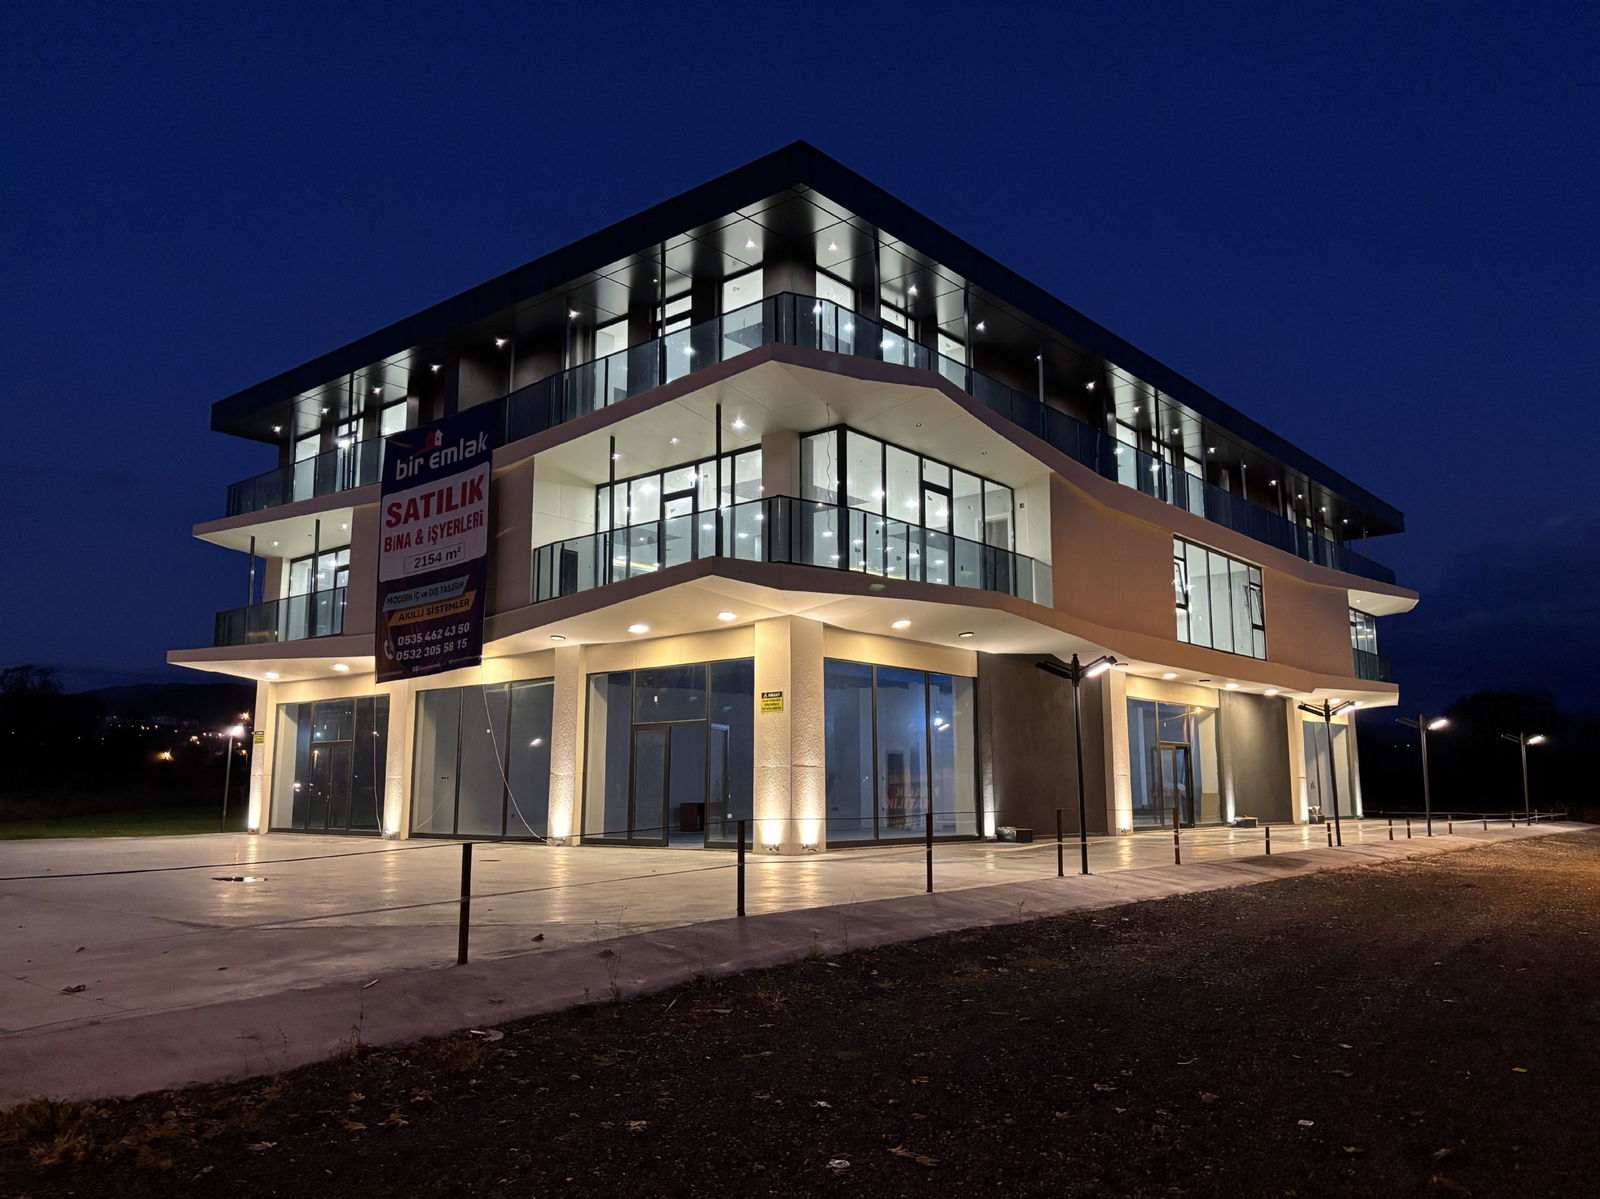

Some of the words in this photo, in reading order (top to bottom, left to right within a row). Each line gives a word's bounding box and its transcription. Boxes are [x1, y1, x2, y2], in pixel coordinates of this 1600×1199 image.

[395, 455, 424, 480] bir
[429, 431, 488, 469] emlak
[385, 474, 484, 528] SATILIK
[384, 532, 411, 552] BİNA
[415, 529, 424, 545] &
[428, 510, 483, 545] İŞYERLERİ
[415, 552, 442, 569] 2154
[398, 610, 424, 621] AKILLI
[426, 598, 470, 616] SİSTEMLER
[397, 633, 423, 646] 0535
[425, 629, 443, 641] 462
[444, 625, 456, 637] 43
[458, 622, 470, 634] 50
[396, 648, 422, 661] 0532
[423, 644, 441, 657] 305
[456, 638, 468, 650] 15
